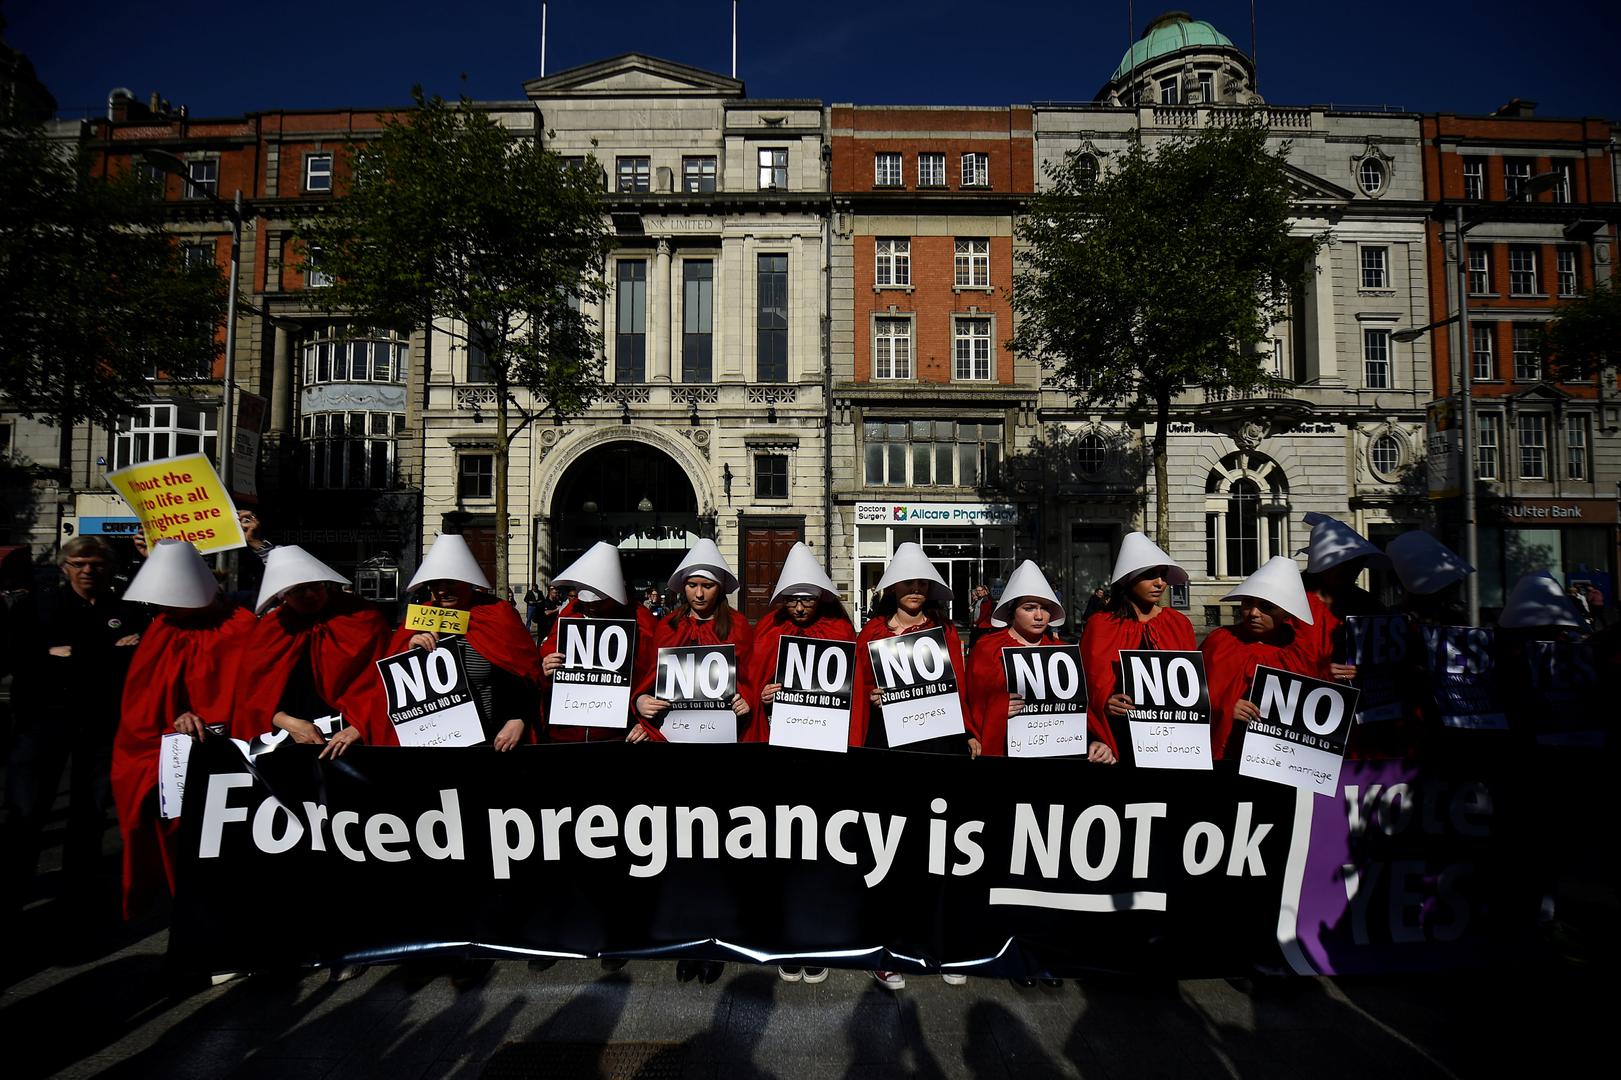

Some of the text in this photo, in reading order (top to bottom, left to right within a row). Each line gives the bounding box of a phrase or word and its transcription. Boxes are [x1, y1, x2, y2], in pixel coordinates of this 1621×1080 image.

[671, 219, 713, 230] LIMITED
[162, 472, 193, 486] the
[156, 492, 185, 508] life
[188, 486, 209, 503] all
[194, 507, 221, 521] are
[858, 513, 887, 521] Surgery
[910, 508, 1016, 521] Allcare Pharmacy
[1513, 505, 1582, 517] Ulster Bank
[420, 607, 459, 619] UNDER
[440, 620, 461, 631] EYE
[565, 624, 629, 672] NO
[1351, 616, 1407, 665] YES
[1422, 627, 1490, 674] YES
[783, 642, 848, 693] NO
[878, 636, 945, 689] NO
[389, 647, 458, 709] NO
[556, 670, 585, 682] Stands
[586, 672, 599, 683] for
[600, 673, 612, 683] NO
[613, 674, 622, 684] to
[664, 651, 729, 700] NO
[1012, 651, 1079, 700] NO
[1130, 656, 1200, 707] NO
[775, 691, 804, 703] Stands
[806, 693, 818, 705] for
[819, 695, 830, 706] NO
[832, 696, 840, 707] to
[882, 689, 910, 702] Stands
[912, 686, 924, 697] for
[925, 684, 936, 695] NO
[938, 683, 947, 692] to
[391, 706, 424, 722] Stands
[423, 701, 438, 713] for
[437, 696, 450, 708] NO
[450, 694, 461, 703] to
[564, 692, 613, 713] tampons
[689, 701, 701, 709] for
[703, 701, 715, 709] NO
[1040, 703, 1053, 712] for
[1054, 702, 1066, 712] NO
[1068, 702, 1077, 711] to
[1260, 674, 1345, 736] NO
[786, 715, 827, 727] condoms
[902, 708, 946, 728] progress
[1128, 709, 1157, 720] Stands
[1159, 709, 1173, 720] for
[1174, 710, 1187, 721] NO
[1189, 710, 1199, 721] to
[672, 718, 716, 733] the pill
[1027, 719, 1065, 731] adoption
[1149, 726, 1176, 736] LGBT
[1010, 734, 1083, 752] by LGBT couples
[1249, 720, 1282, 736] Stands
[1284, 727, 1300, 741] for
[1302, 734, 1316, 746] NO
[1319, 738, 1330, 750] to
[1137, 740, 1201, 754] blood donors
[1273, 742, 1296, 755] sex
[1246, 753, 1333, 785] outside marriage
[1343, 774, 1494, 837] vote
[199, 773, 1274, 889] Forced pregnancy is NOT ok
[1342, 859, 1475, 946] YES
